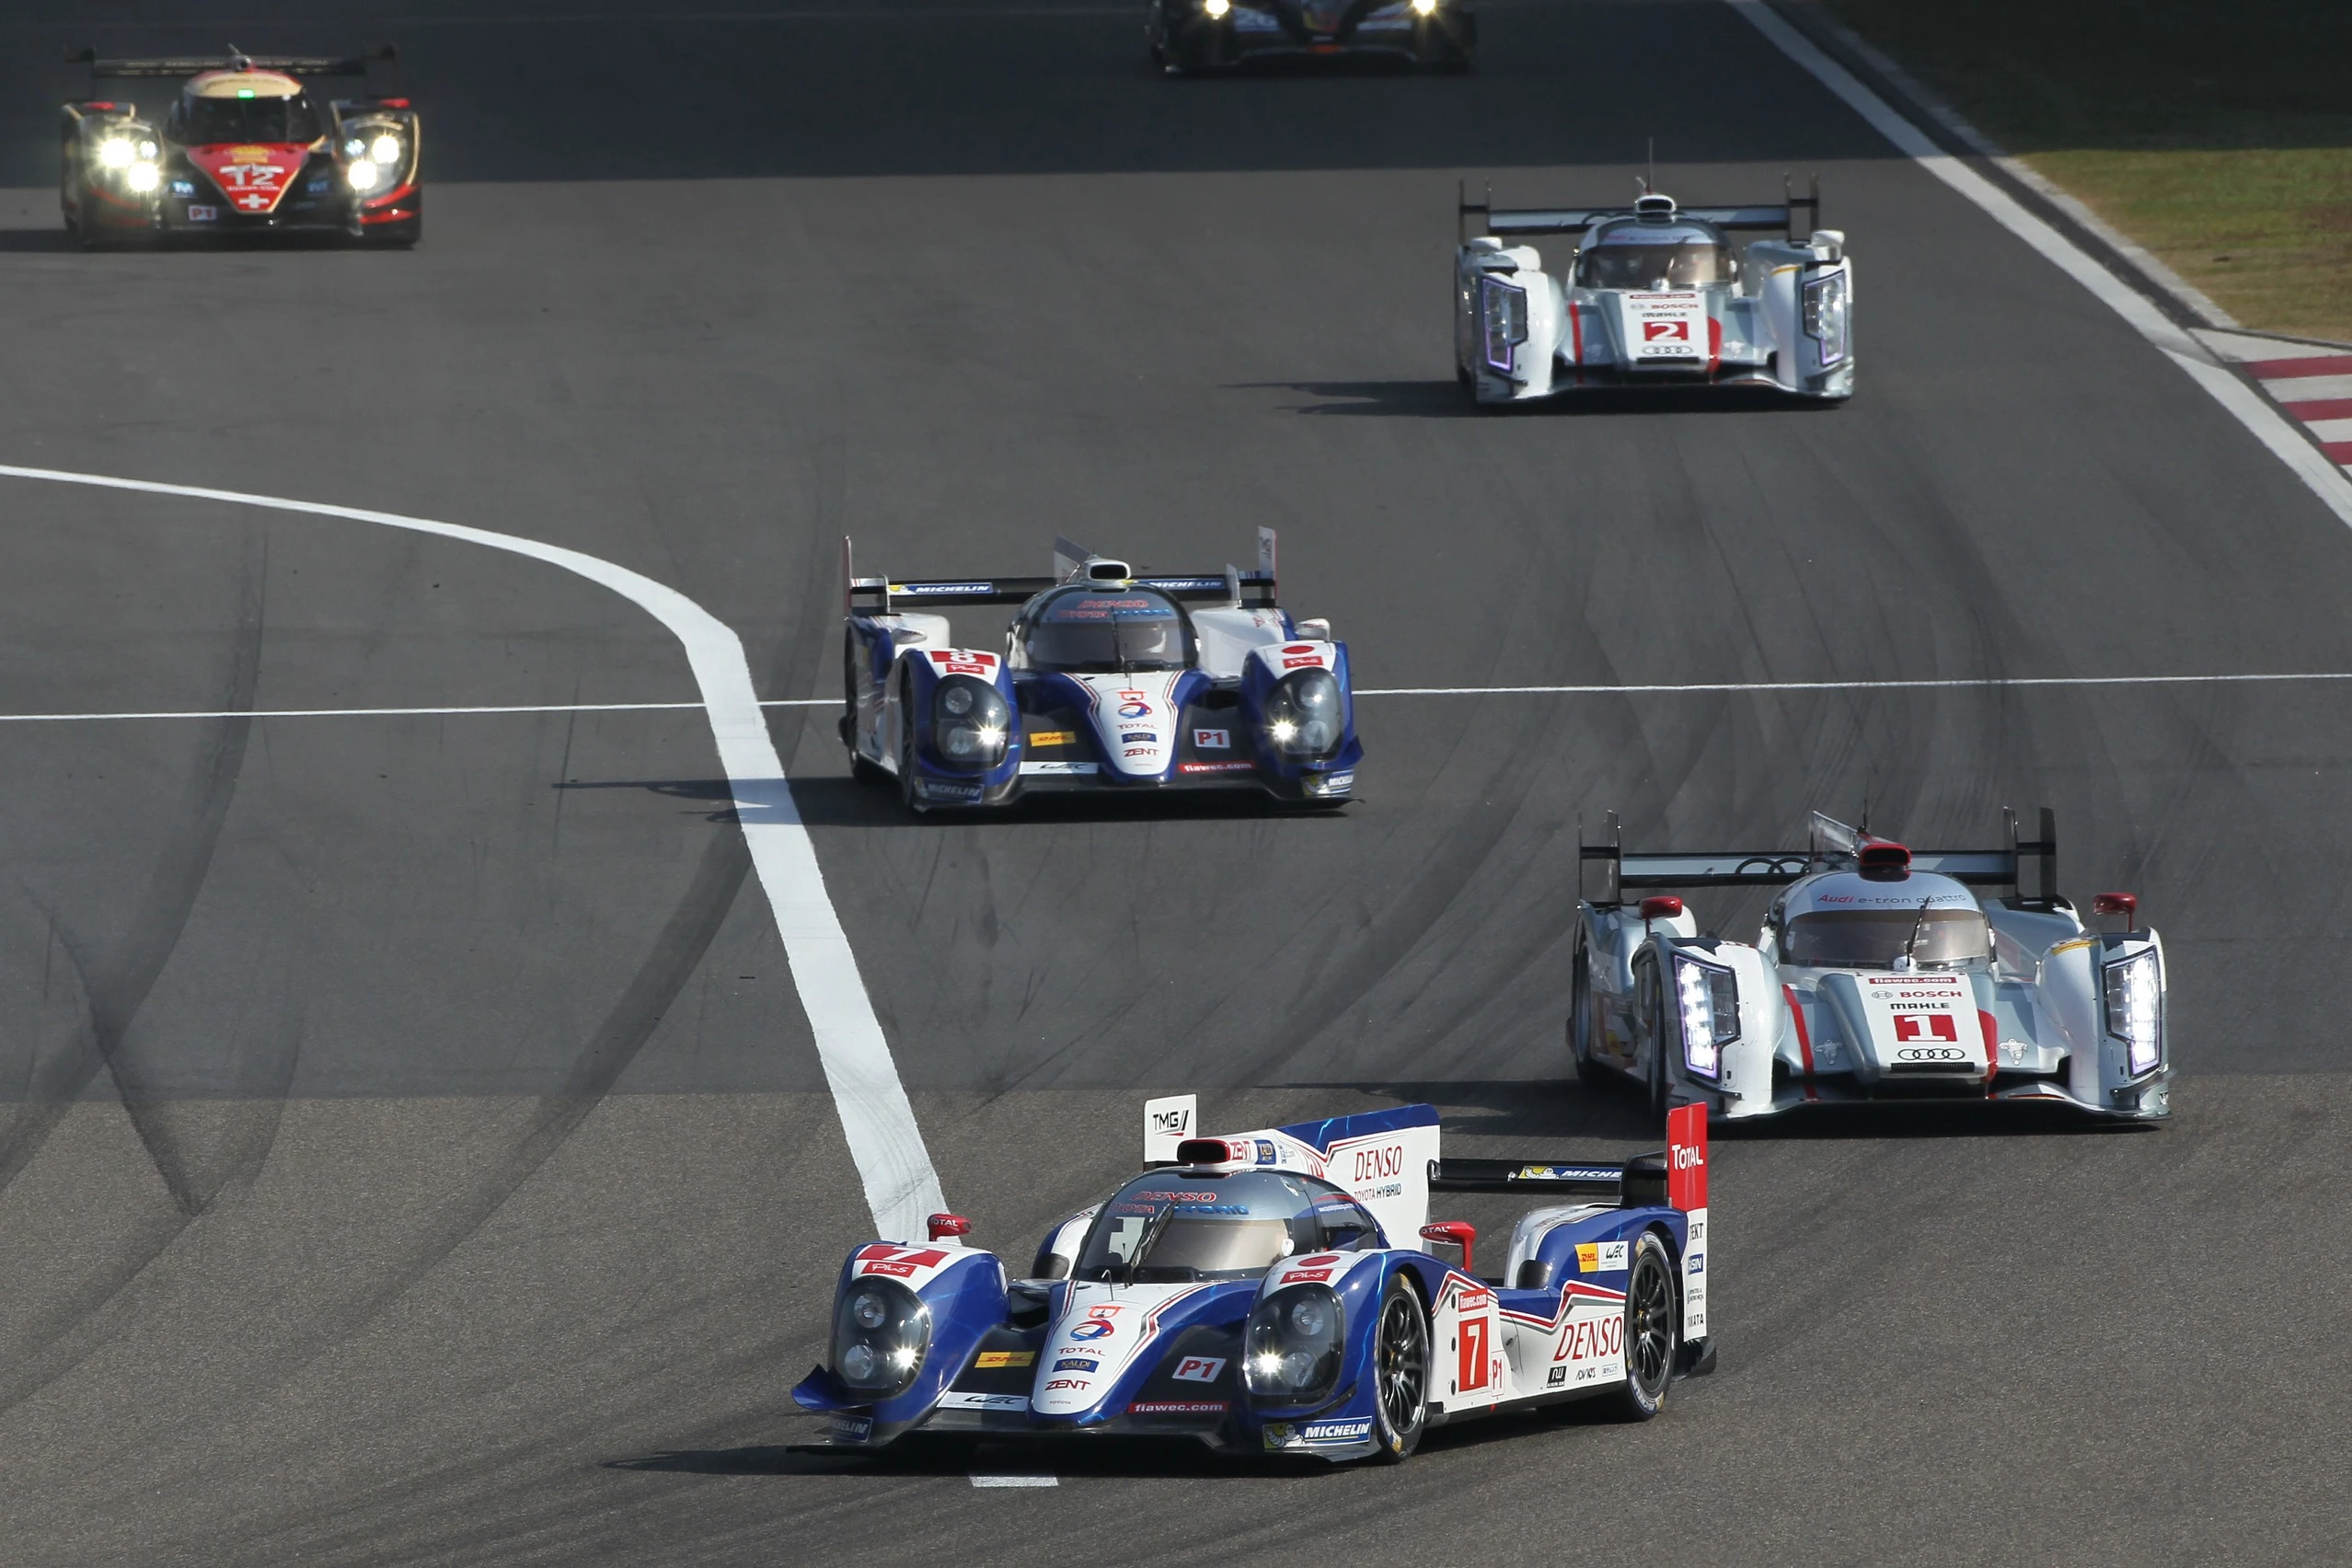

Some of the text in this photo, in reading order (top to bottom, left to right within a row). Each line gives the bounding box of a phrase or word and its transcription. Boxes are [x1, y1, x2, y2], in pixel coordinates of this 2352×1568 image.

[1650, 322, 1679, 341] 2
[1198, 732, 1224, 745] P1
[1124, 748, 1159, 757] ZENT
[1183, 763, 1252, 772] fiawec.com
[928, 784, 981, 798] MICHELIN
[1817, 894, 1855, 904] Audi
[1889, 1002, 1951, 1010] MAHLE
[1903, 1015, 1947, 1042] 1
[1671, 1144, 1704, 1170] TOTAL
[1355, 1146, 1402, 1182] DENSO
[1561, 1170, 1623, 1179] MICHE
[1130, 1191, 1217, 1203] DENSO
[1355, 1183, 1402, 1202] TOYOTA HYBRID
[929, 1217, 959, 1227] TOTAL
[1421, 1226, 1448, 1235] OTAL
[1553, 1316, 1623, 1362] DENSO
[1058, 1346, 1107, 1357] TOTAL
[1467, 1323, 1481, 1386] 7
[1061, 1360, 1091, 1368] KALDI
[1178, 1359, 1216, 1378] P1
[1492, 1358, 1503, 1390] P1
[1044, 1379, 1091, 1391] ZENT
[963, 1395, 1025, 1405] WEC
[1135, 1403, 1223, 1412] fiawec.com
[1304, 1423, 1371, 1438] MICHELIN
